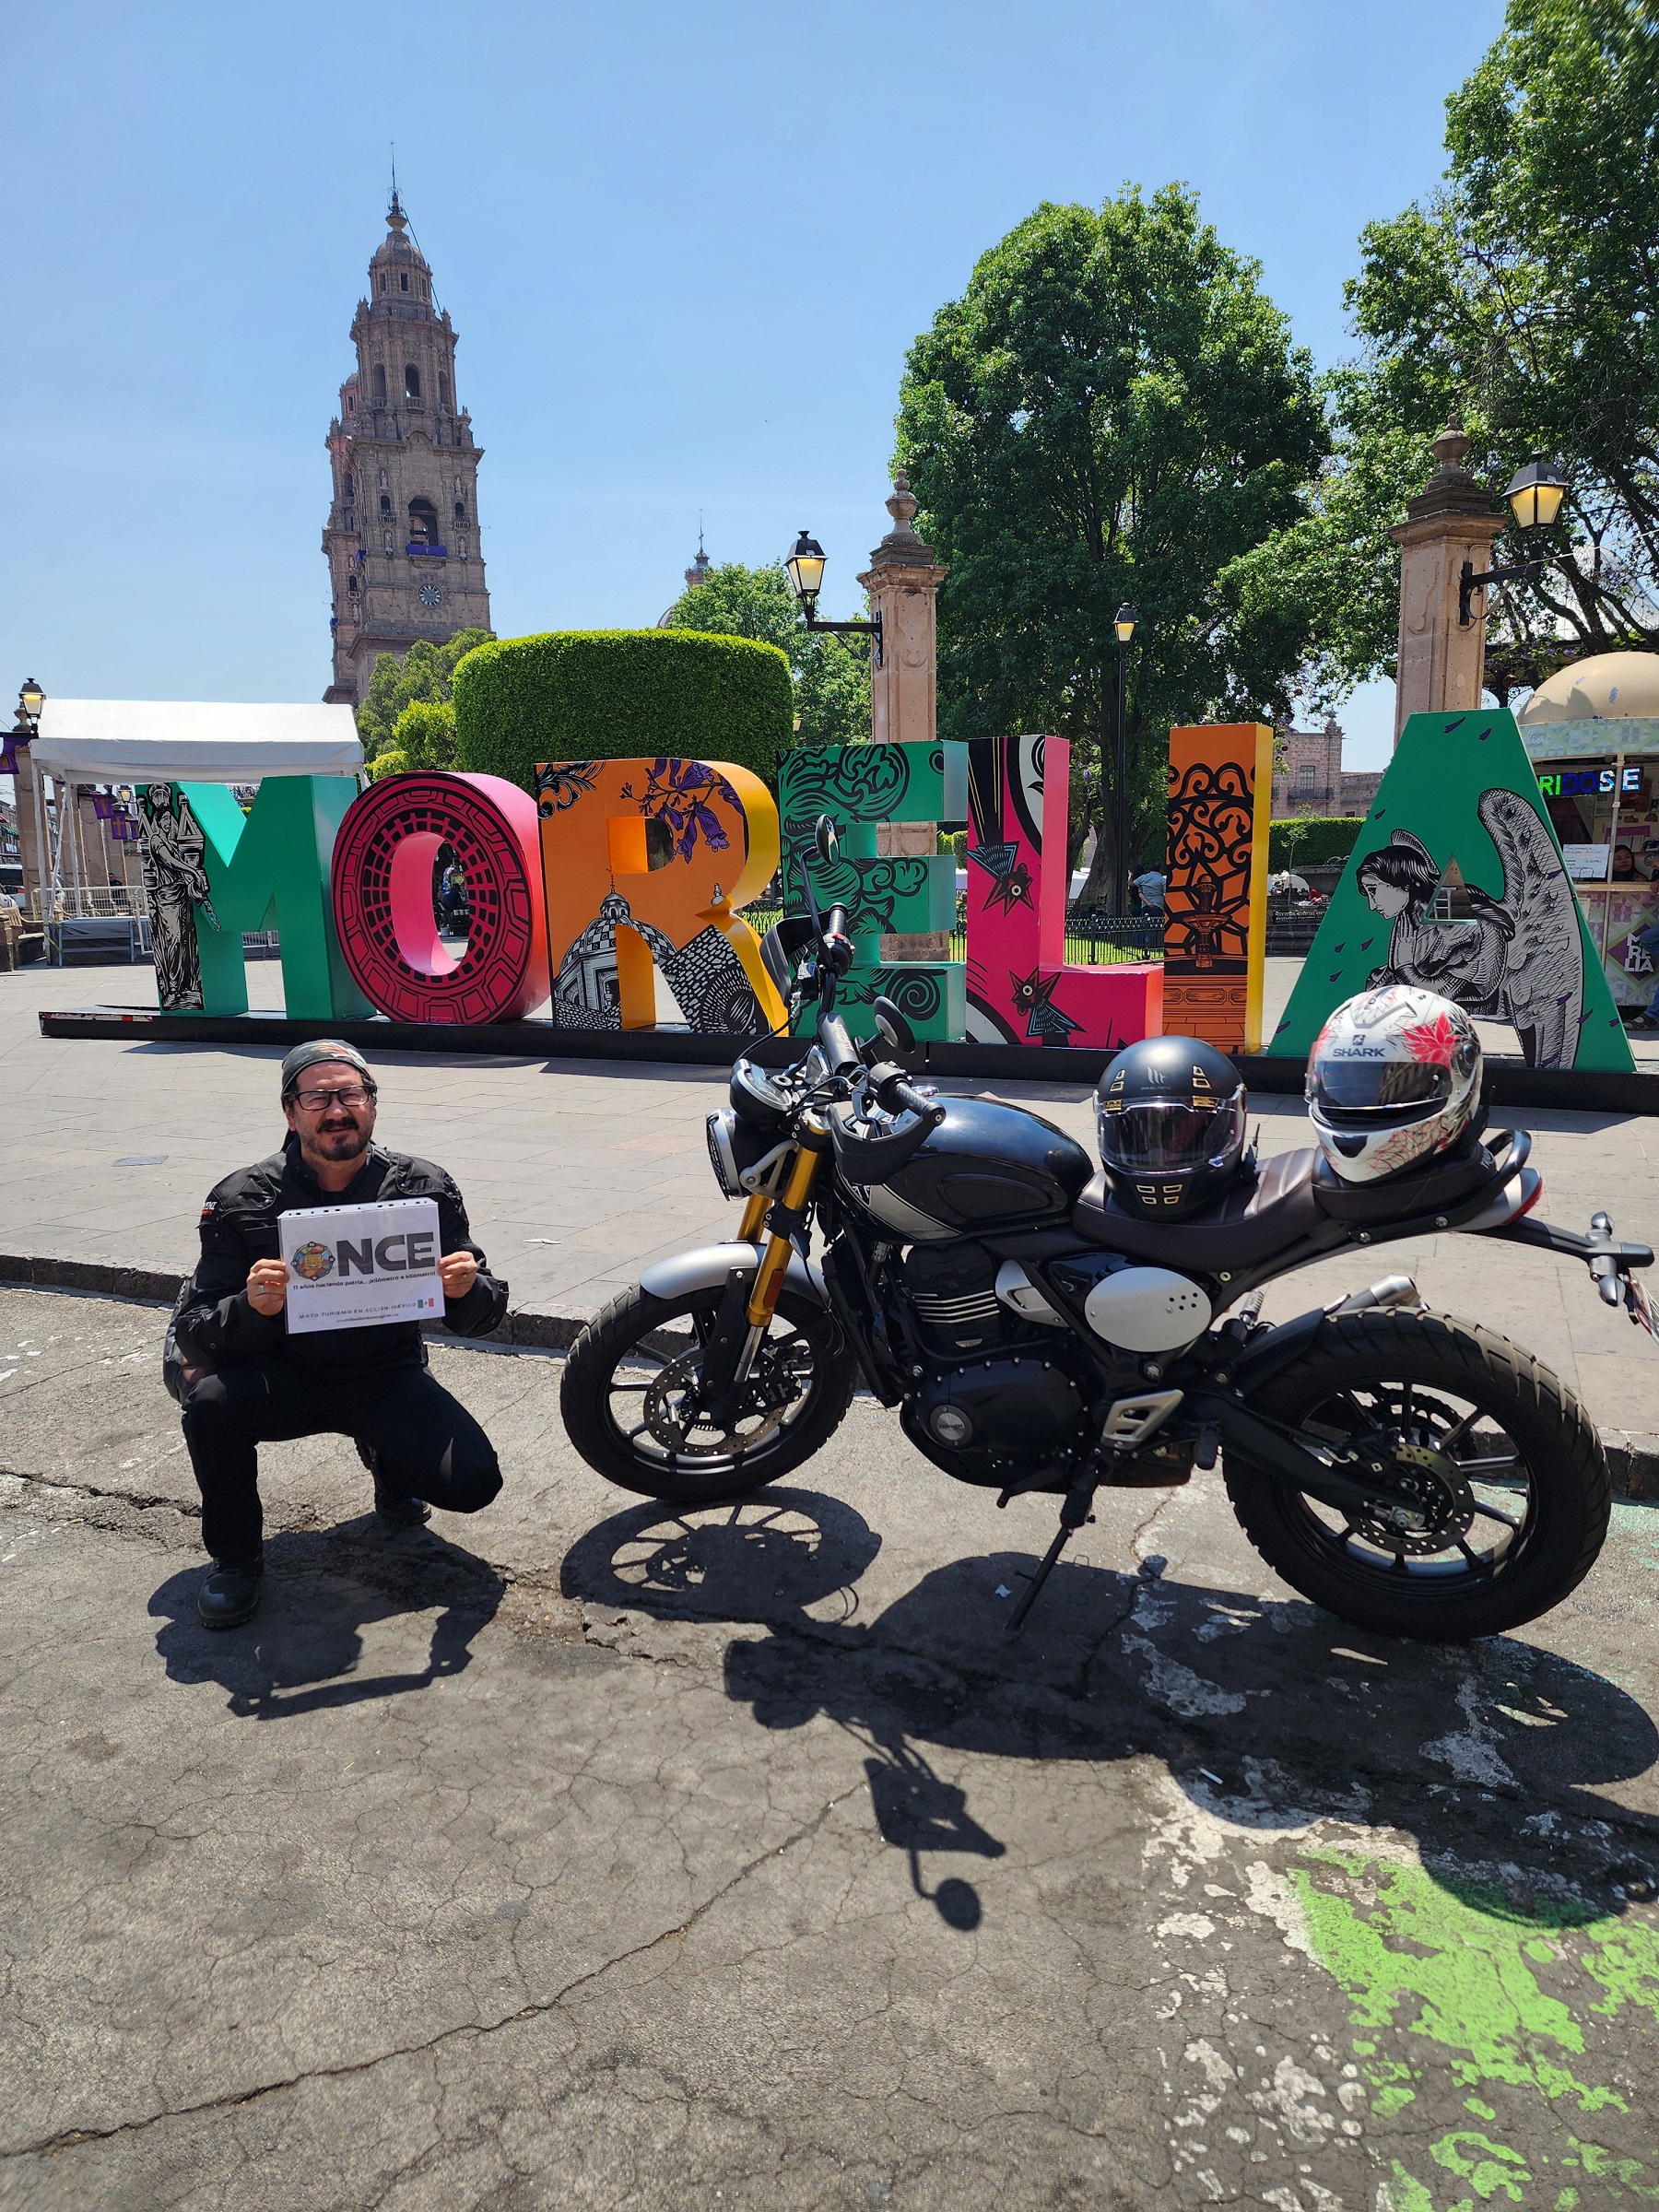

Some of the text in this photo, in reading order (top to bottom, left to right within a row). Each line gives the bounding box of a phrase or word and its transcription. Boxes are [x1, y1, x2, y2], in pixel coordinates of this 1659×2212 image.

[135, 708, 1635, 1074] MORELIA
[1624, 958, 1654, 972] LIA
[1333, 1047, 1386, 1058] SHARK
[315, 1280, 344, 1288] haciendo
